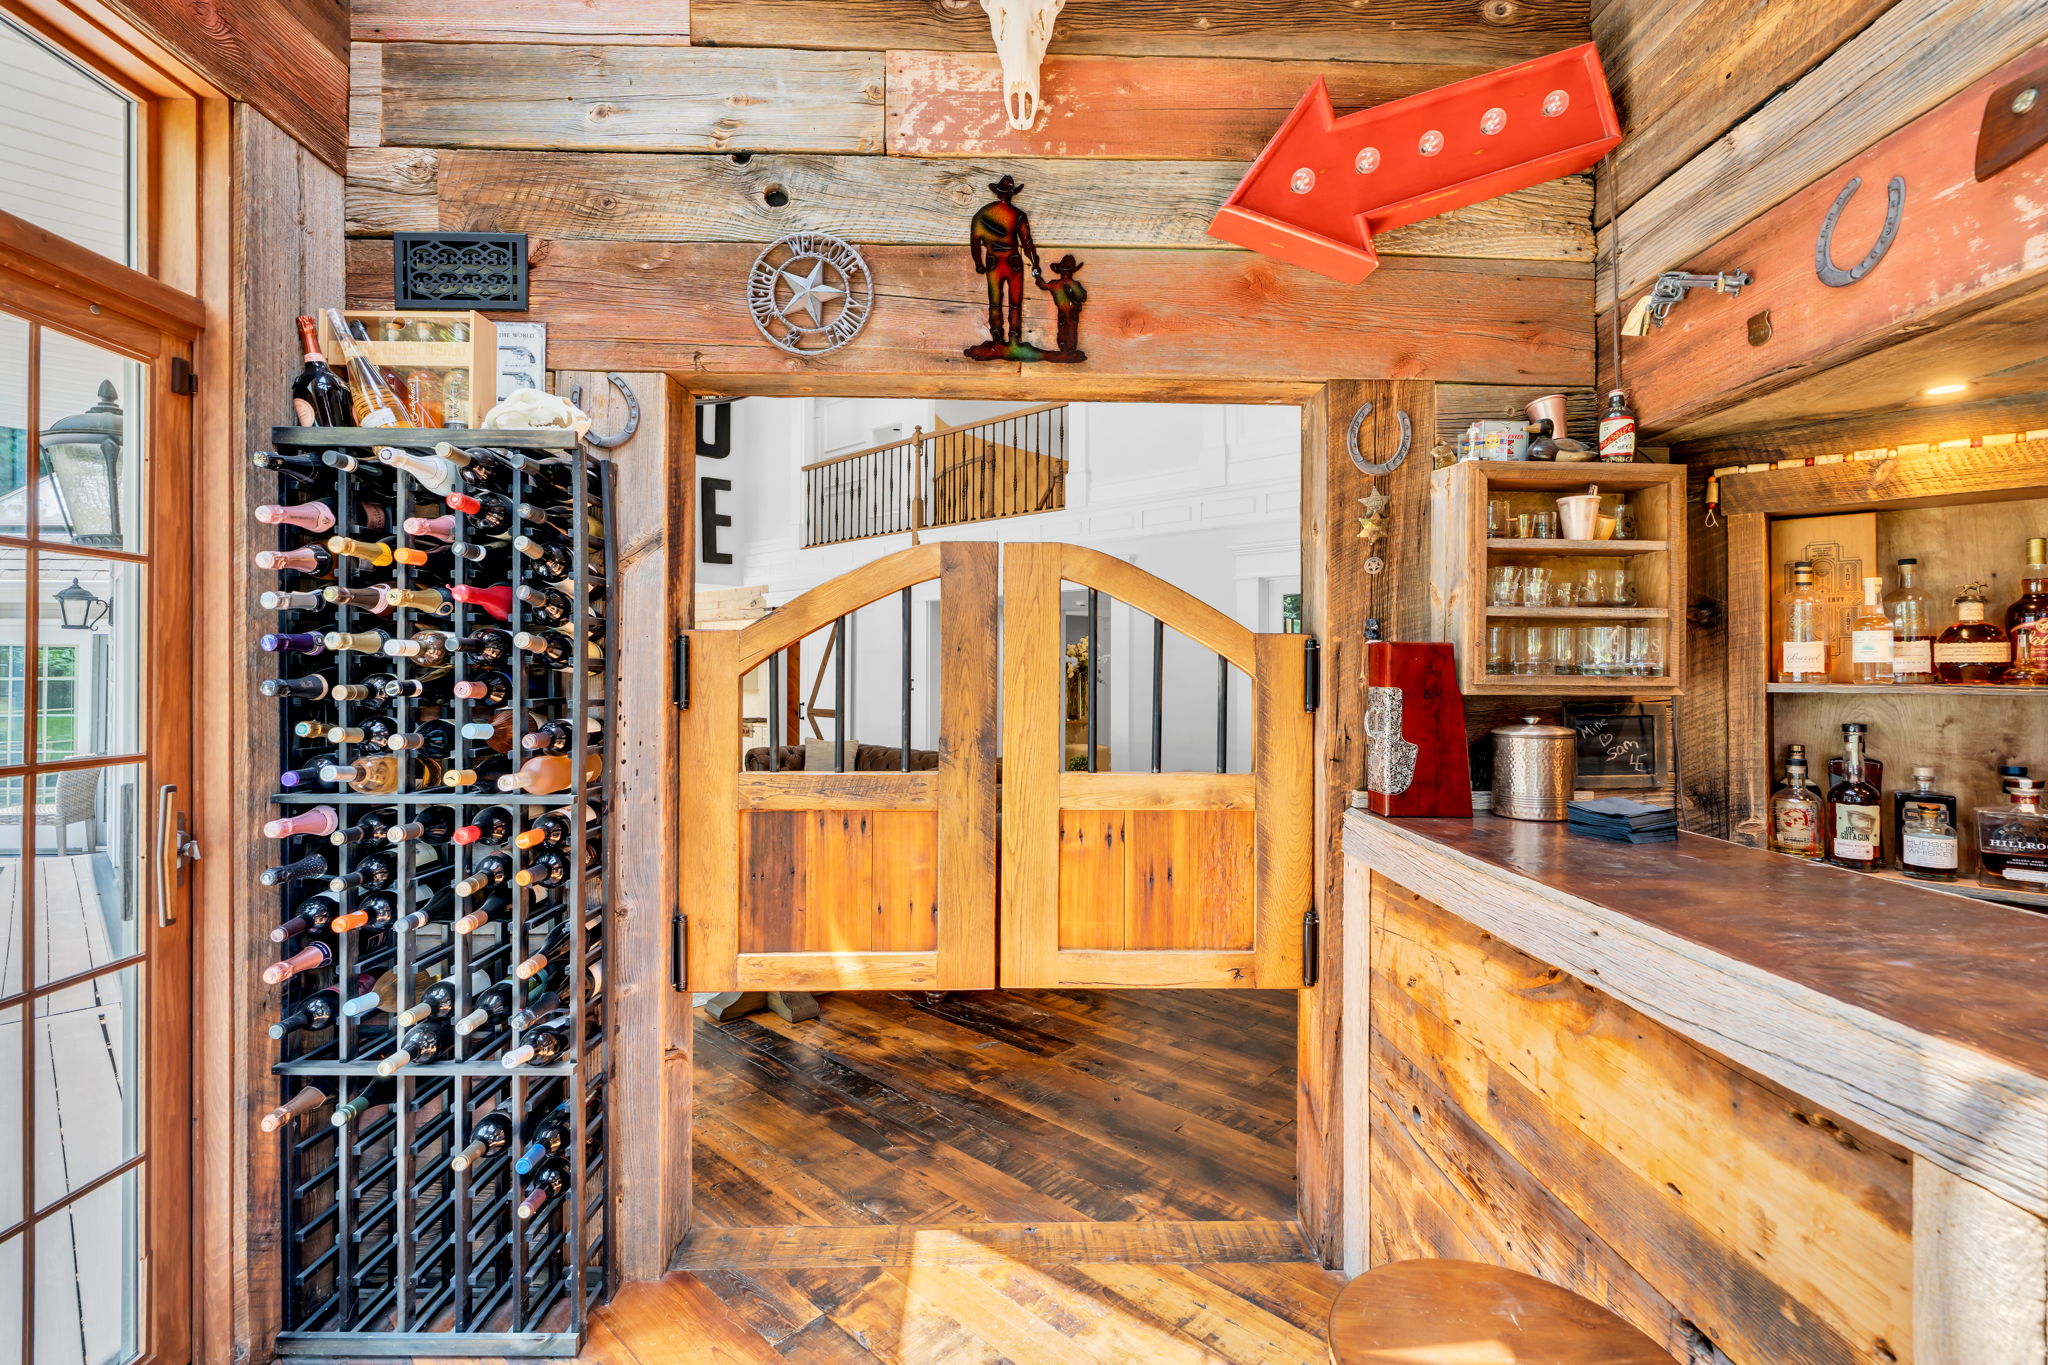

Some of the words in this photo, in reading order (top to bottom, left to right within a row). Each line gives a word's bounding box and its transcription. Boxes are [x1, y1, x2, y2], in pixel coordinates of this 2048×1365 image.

[786, 235, 862, 279] WELCOME
[749, 260, 777, 328] FRIENDS
[780, 328, 801, 348] &
[825, 296, 868, 347] FAMILY
[1844, 826, 1855, 834] JOE
[1906, 838, 1955, 850] HUDSON
[1989, 838, 2048, 851] HILLRO
[1906, 847, 1954, 858] WHISKEY
